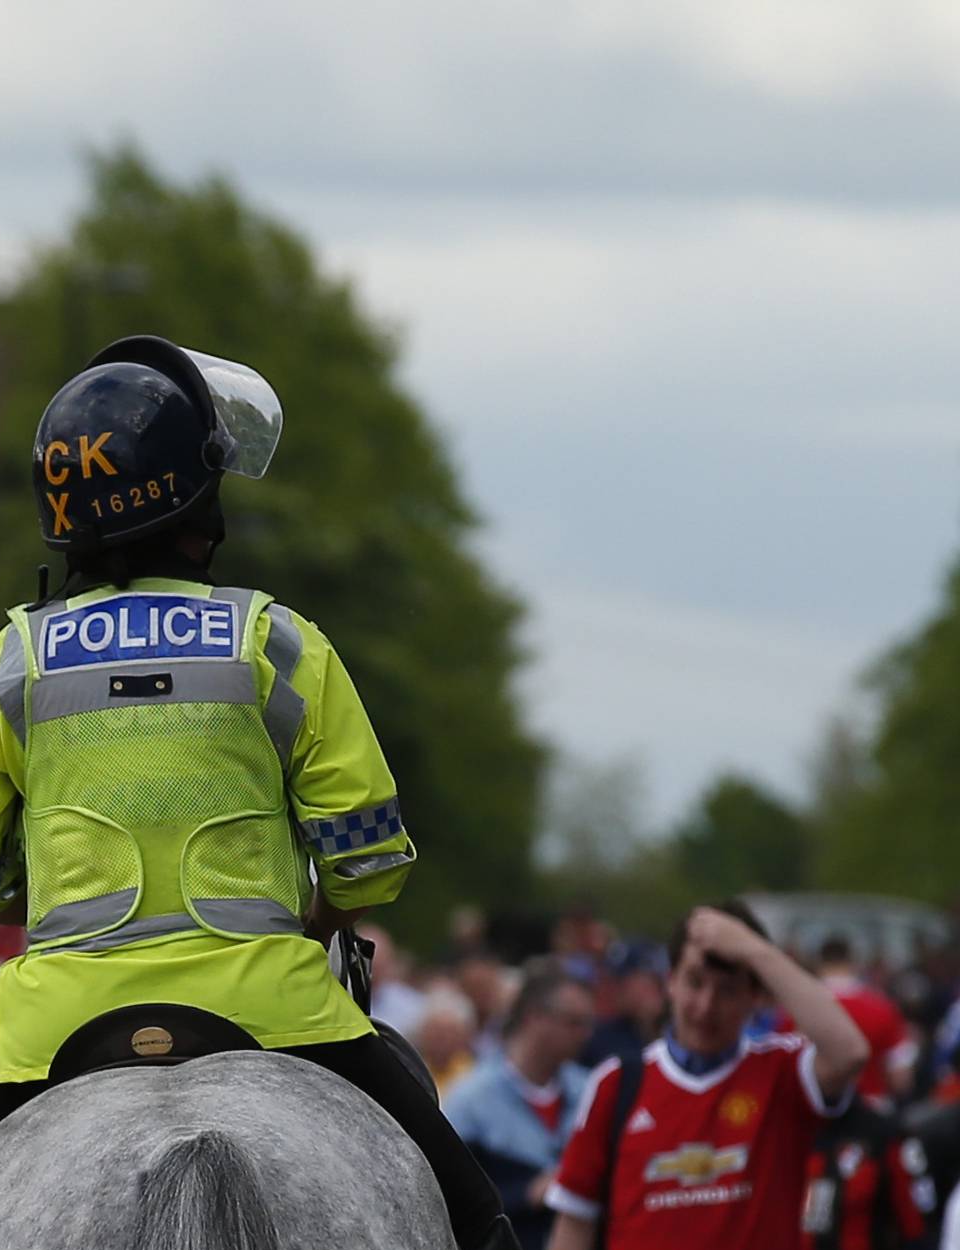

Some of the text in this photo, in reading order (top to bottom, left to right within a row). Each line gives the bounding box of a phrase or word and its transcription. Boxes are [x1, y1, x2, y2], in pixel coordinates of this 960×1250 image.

[45, 431, 119, 487] CK
[46, 492, 75, 537] X
[91, 472, 177, 518] 16287
[47, 606, 231, 658] POLICE
